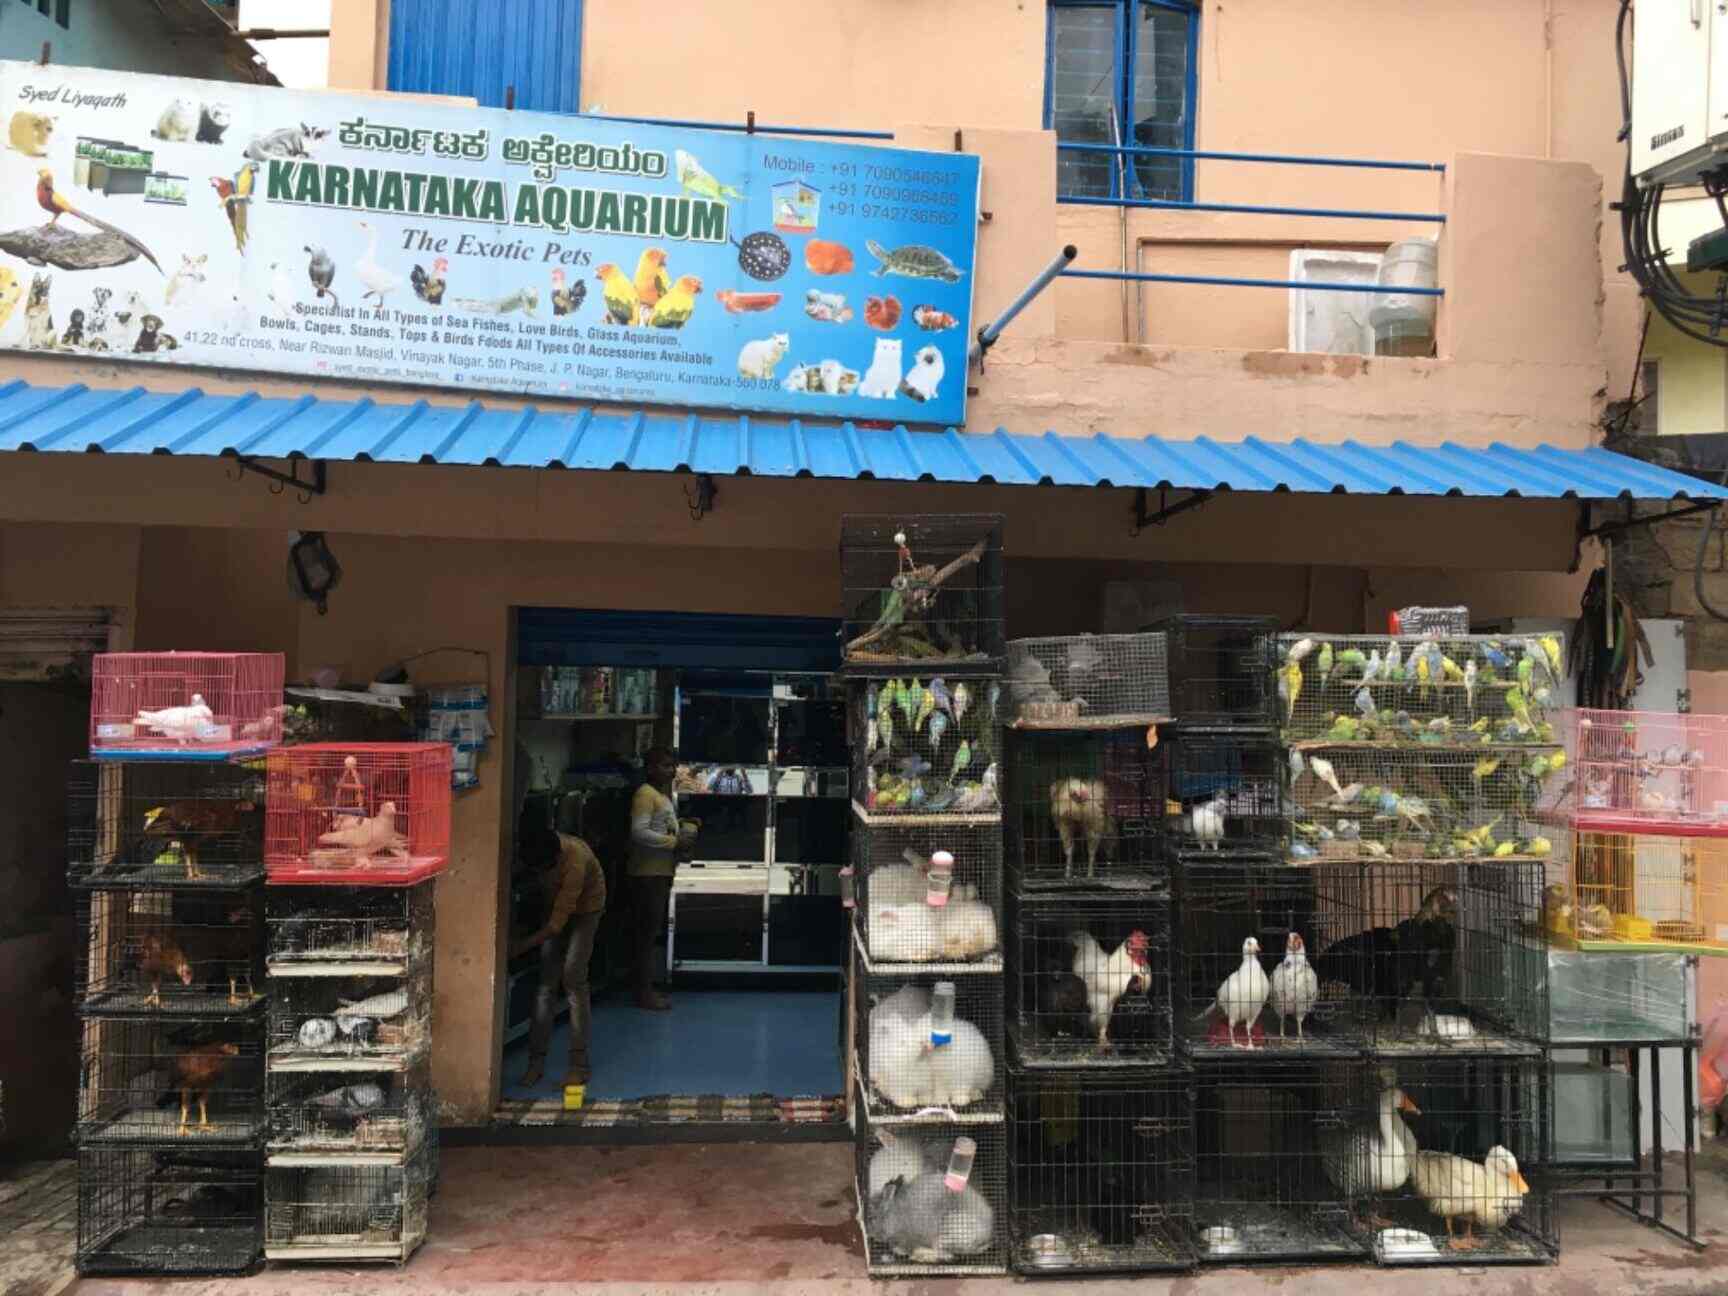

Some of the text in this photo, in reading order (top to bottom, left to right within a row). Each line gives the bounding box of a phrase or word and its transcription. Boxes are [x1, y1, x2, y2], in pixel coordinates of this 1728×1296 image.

[18, 84, 128, 110] Syed Liyaqath
[338, 116, 488, 161] ಕರ್ನಾಟಕ
[763, 154, 815, 174] Mobile
[831, 162, 857, 177] +91
[267, 159, 727, 242] KARNATAKA AQUARIUM
[829, 183, 857, 198] +91
[828, 202, 857, 217] +91
[402, 228, 593, 266] The Exotic Pets
[359, 307, 370, 320] In
[373, 308, 390, 321] All
[394, 310, 428, 326] Types
[446, 315, 468, 329] Sea
[472, 317, 514, 334] Fishes,
[518, 320, 546, 335] Love
[587, 327, 620, 342] Glass
[622, 330, 681, 347] Aquarium,
[279, 338, 306, 352] Near
[401, 349, 445, 365] Vinayak
[488, 355, 507, 369] 5th
[399, 327, 427, 343] Tops
[431, 330, 440, 343] &
[443, 331, 474, 346] Birds
[515, 337, 532, 351] All
[536, 339, 569, 355] Types
[588, 344, 657, 361] Accessories
[659, 350, 713, 366] Available
